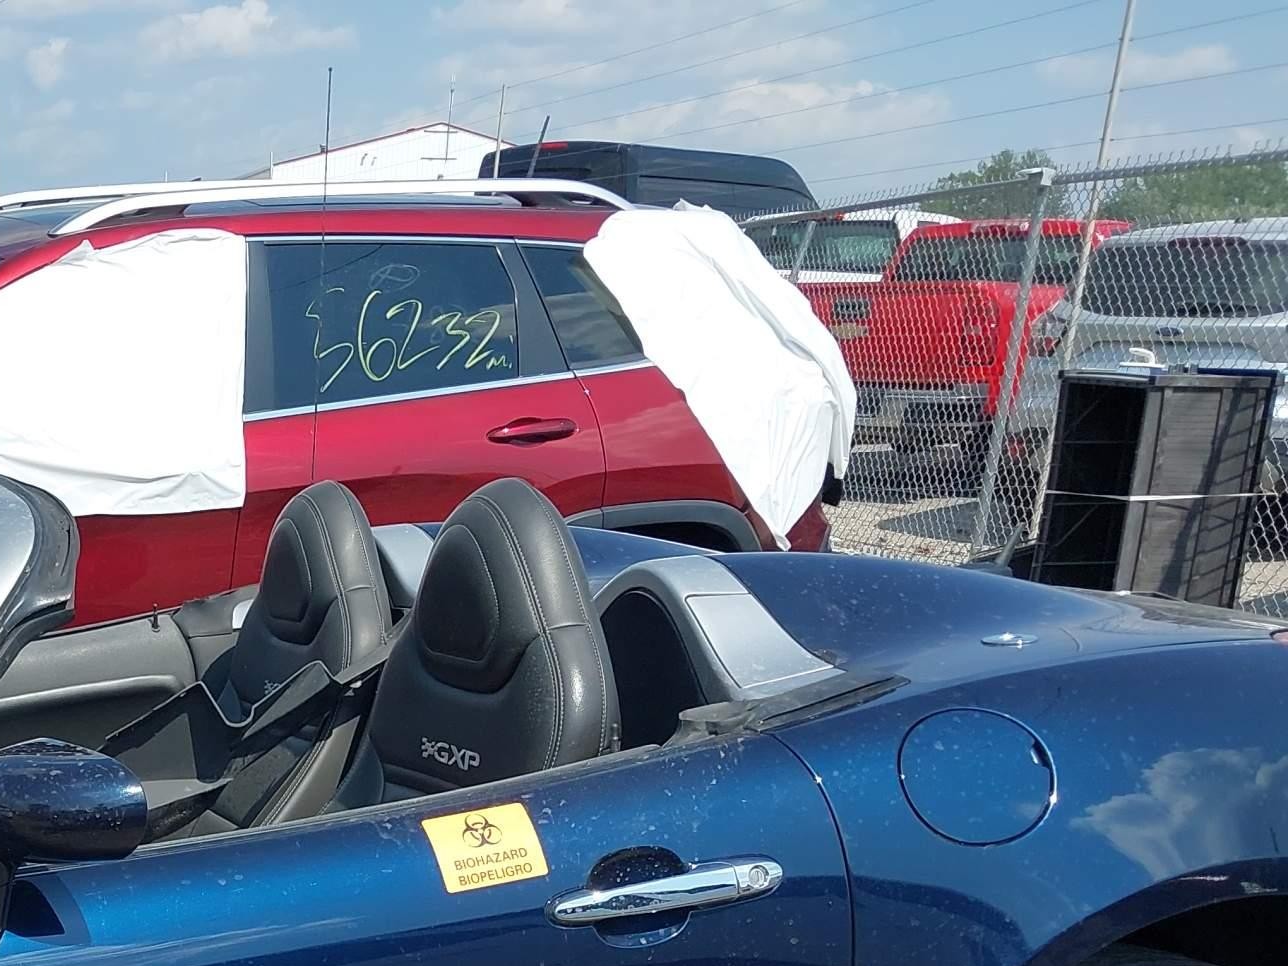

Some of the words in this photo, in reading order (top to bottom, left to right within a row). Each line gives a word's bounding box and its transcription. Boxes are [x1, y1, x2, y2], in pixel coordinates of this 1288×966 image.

[305, 287, 501, 393] 56232
[434, 742, 480, 771] GXP
[454, 847, 528, 871] BIOHAZARD
[458, 862, 533, 886] BIOPELIGRO
